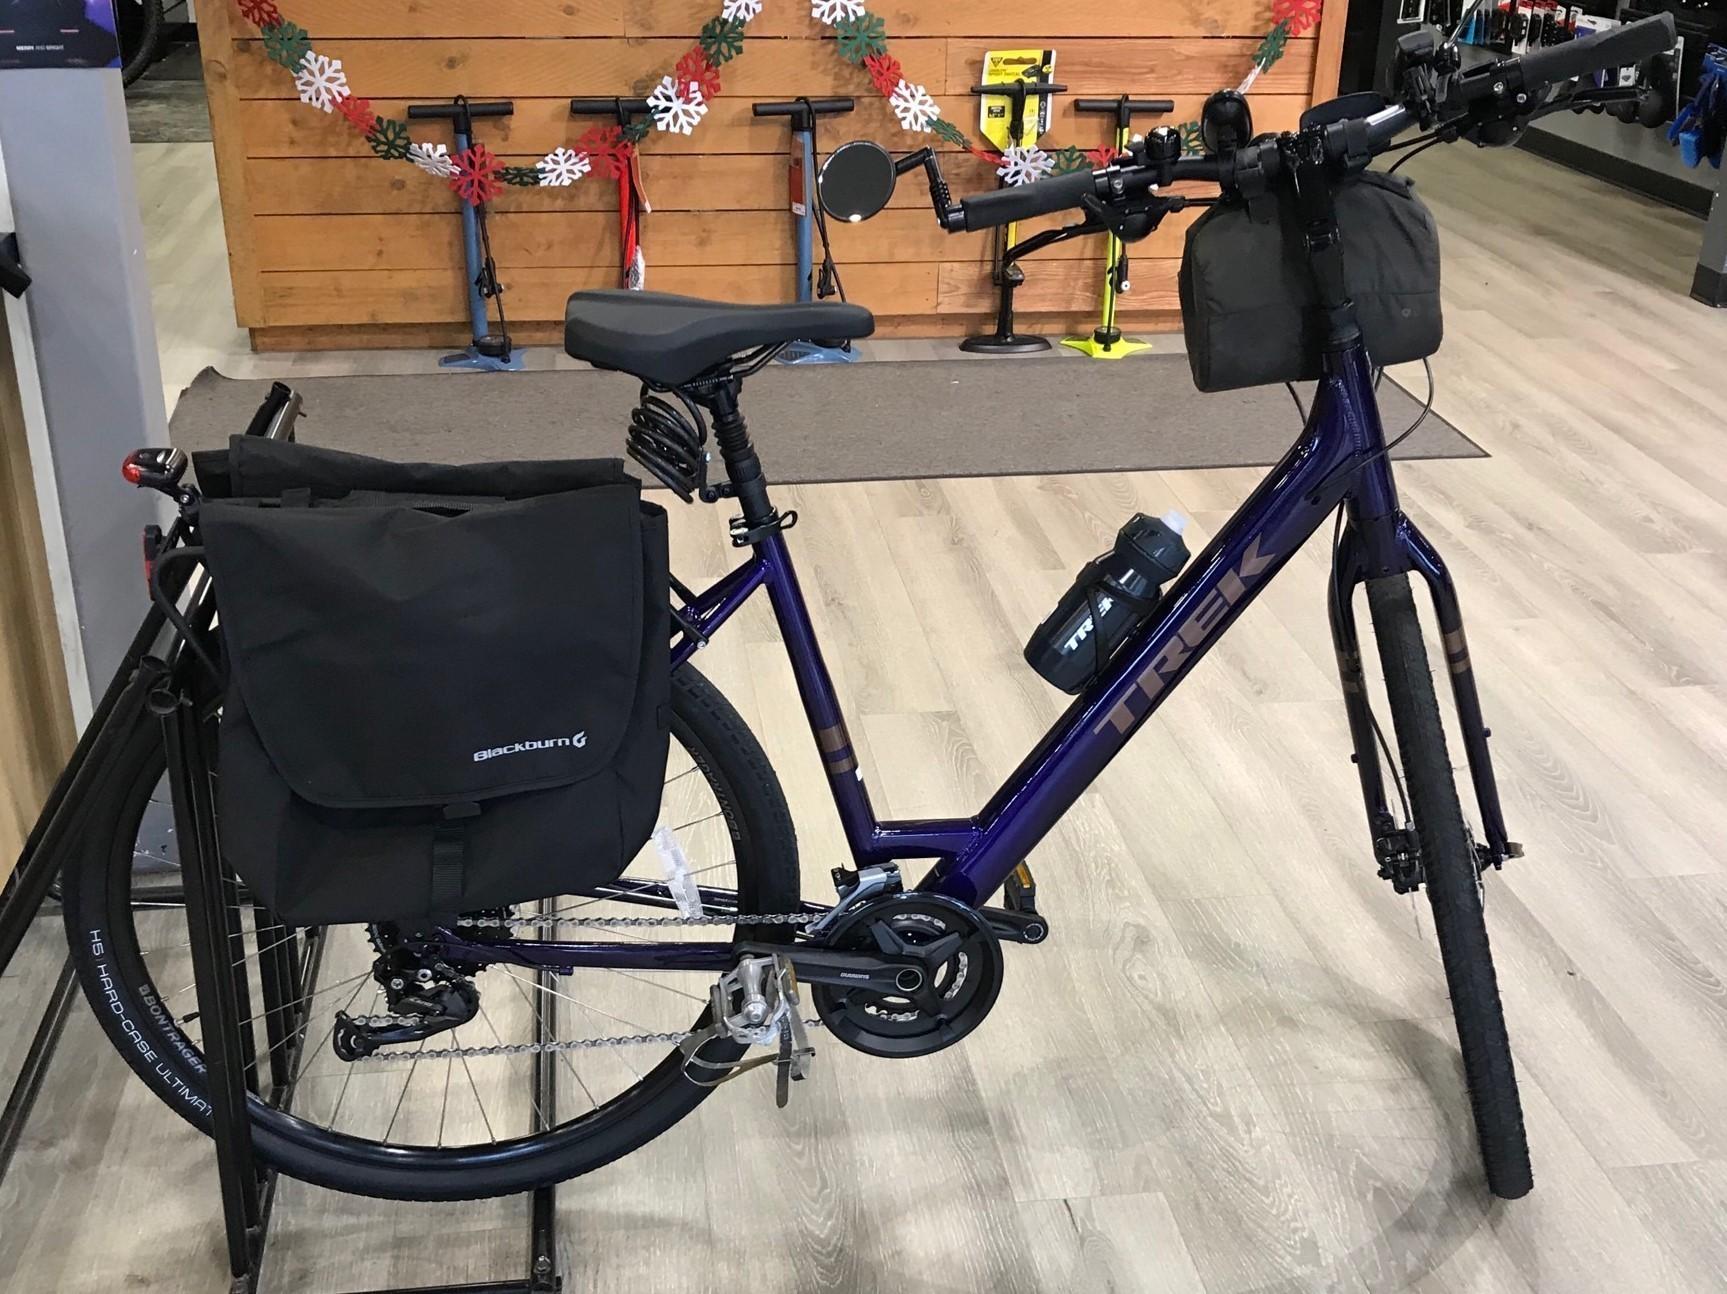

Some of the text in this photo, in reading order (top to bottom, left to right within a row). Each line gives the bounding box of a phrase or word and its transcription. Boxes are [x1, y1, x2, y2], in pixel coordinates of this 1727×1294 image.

[1093, 532, 1277, 736] TREK
[473, 738, 570, 762] Blackburn
[97, 964, 159, 1063] HARD-CASE
[142, 994, 207, 1074] BONTRAGER
